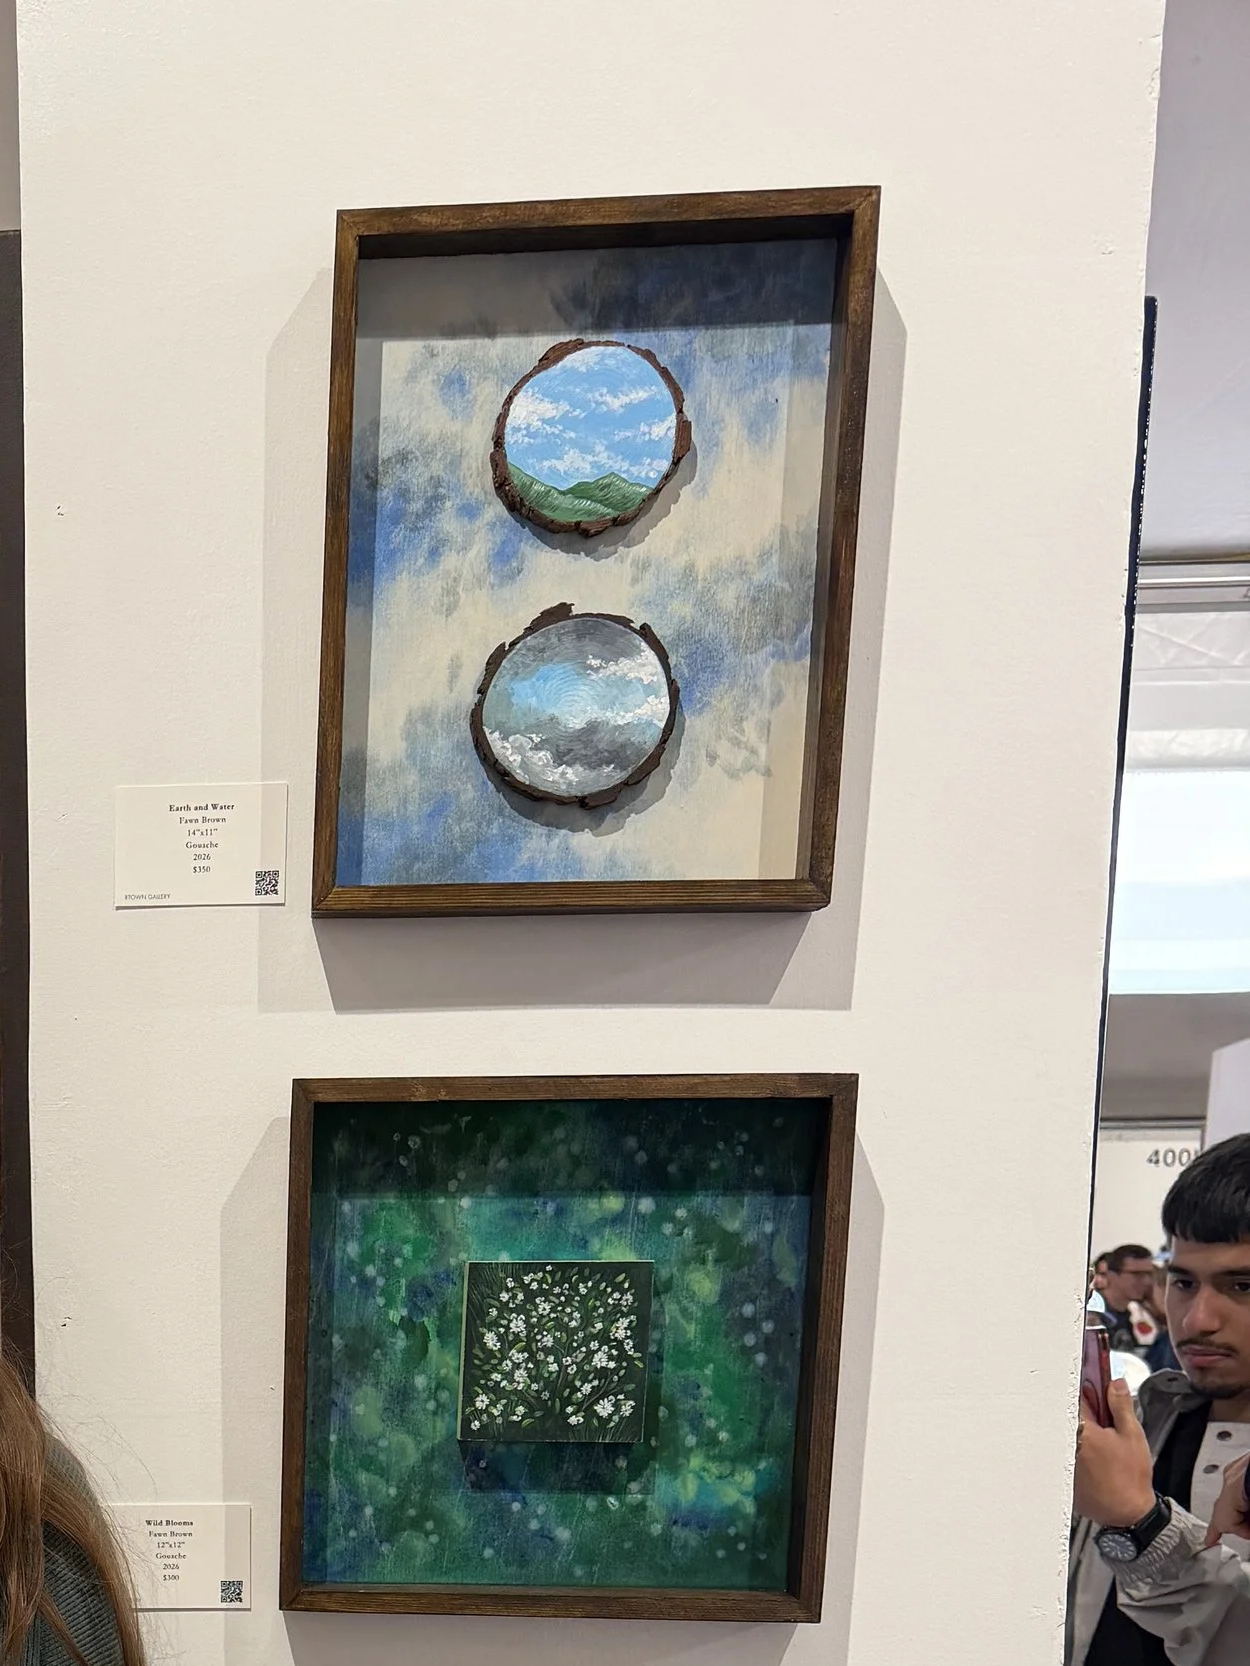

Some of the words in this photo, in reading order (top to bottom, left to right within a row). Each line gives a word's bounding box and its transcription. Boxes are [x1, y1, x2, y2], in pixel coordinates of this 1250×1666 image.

[168, 803, 191, 812] Earth
[194, 803, 209, 811] and
[211, 803, 235, 811] Water
[179, 816, 199, 824] Fawn
[202, 816, 226, 824] Brown
[185, 841, 219, 849] Gouache
[193, 853, 211, 861] 2026
[145, 1519, 163, 1527] Wild
[165, 1519, 194, 1527] Blooms
[155, 1552, 187, 1560] Gouache
